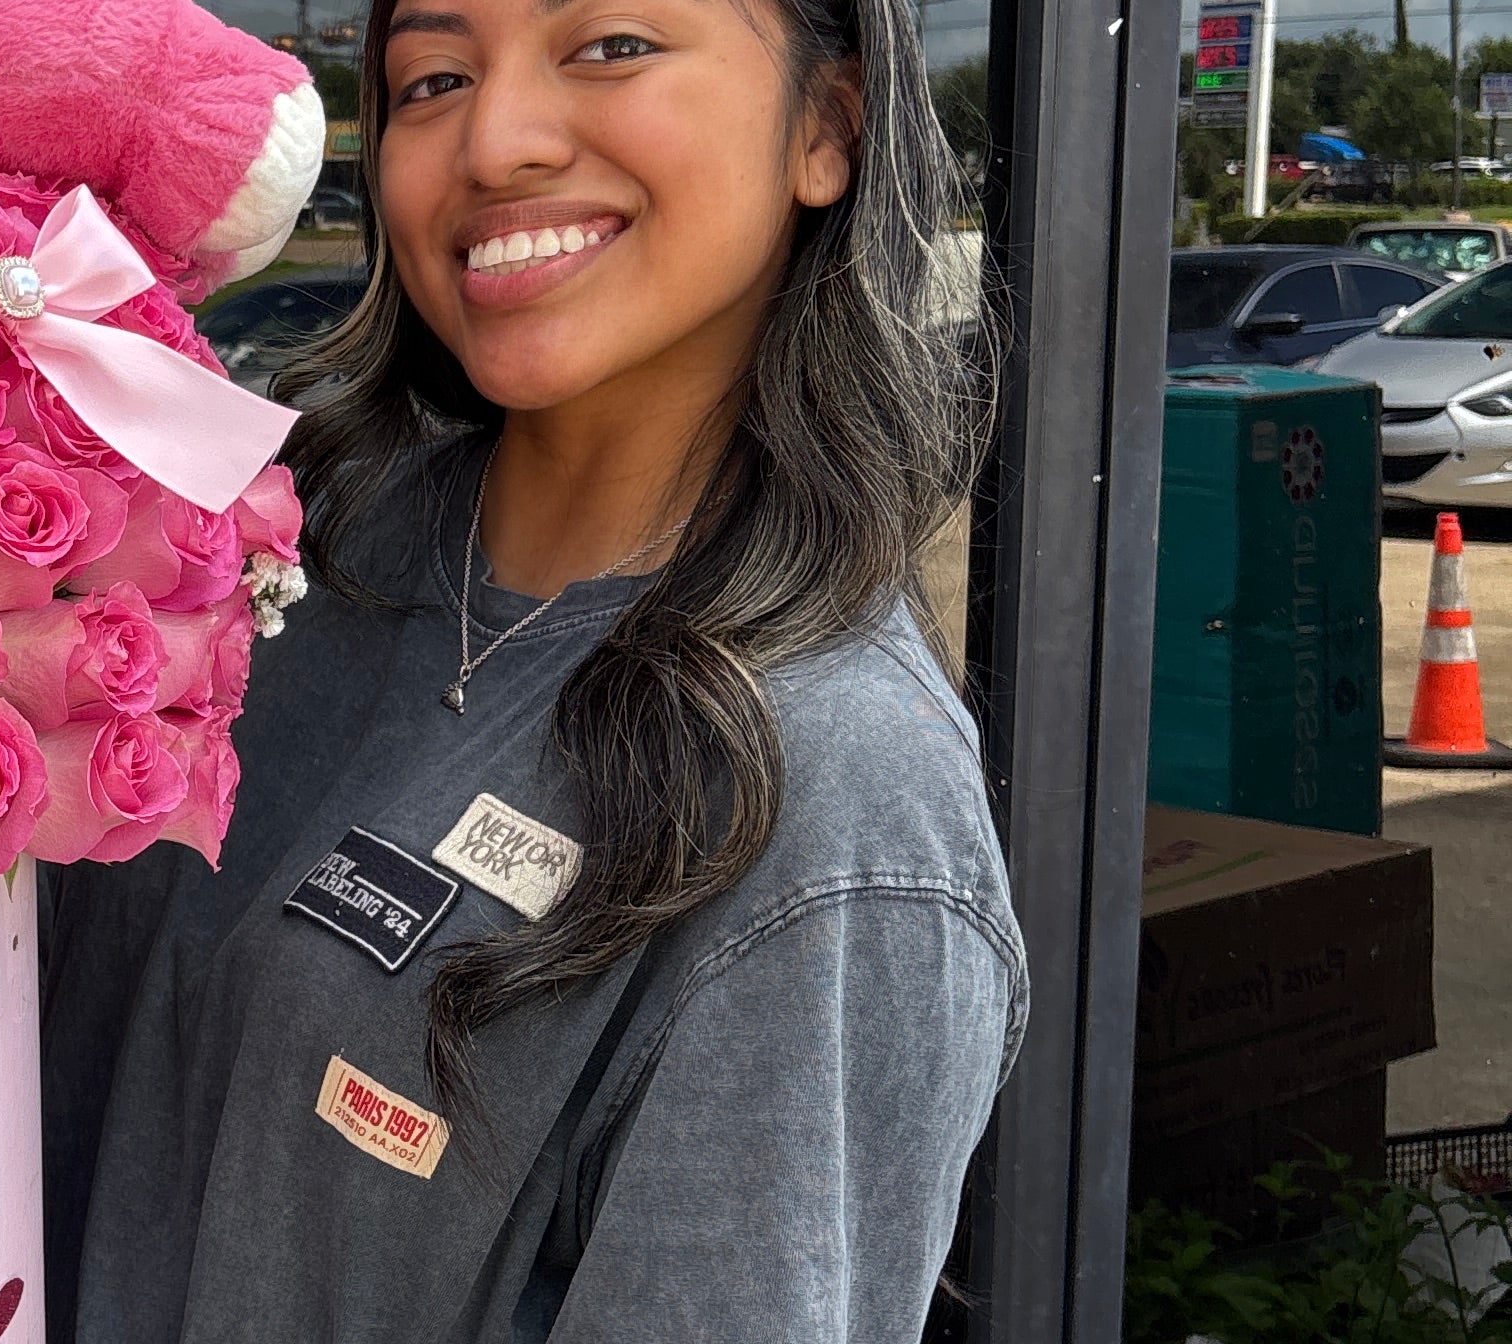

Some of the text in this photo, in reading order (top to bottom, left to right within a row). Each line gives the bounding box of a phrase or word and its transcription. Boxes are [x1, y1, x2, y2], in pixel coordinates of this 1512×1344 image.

[458, 834, 524, 881] YORK
[308, 868, 384, 918] LABELING
[341, 1077, 429, 1148] PARIS 1992
